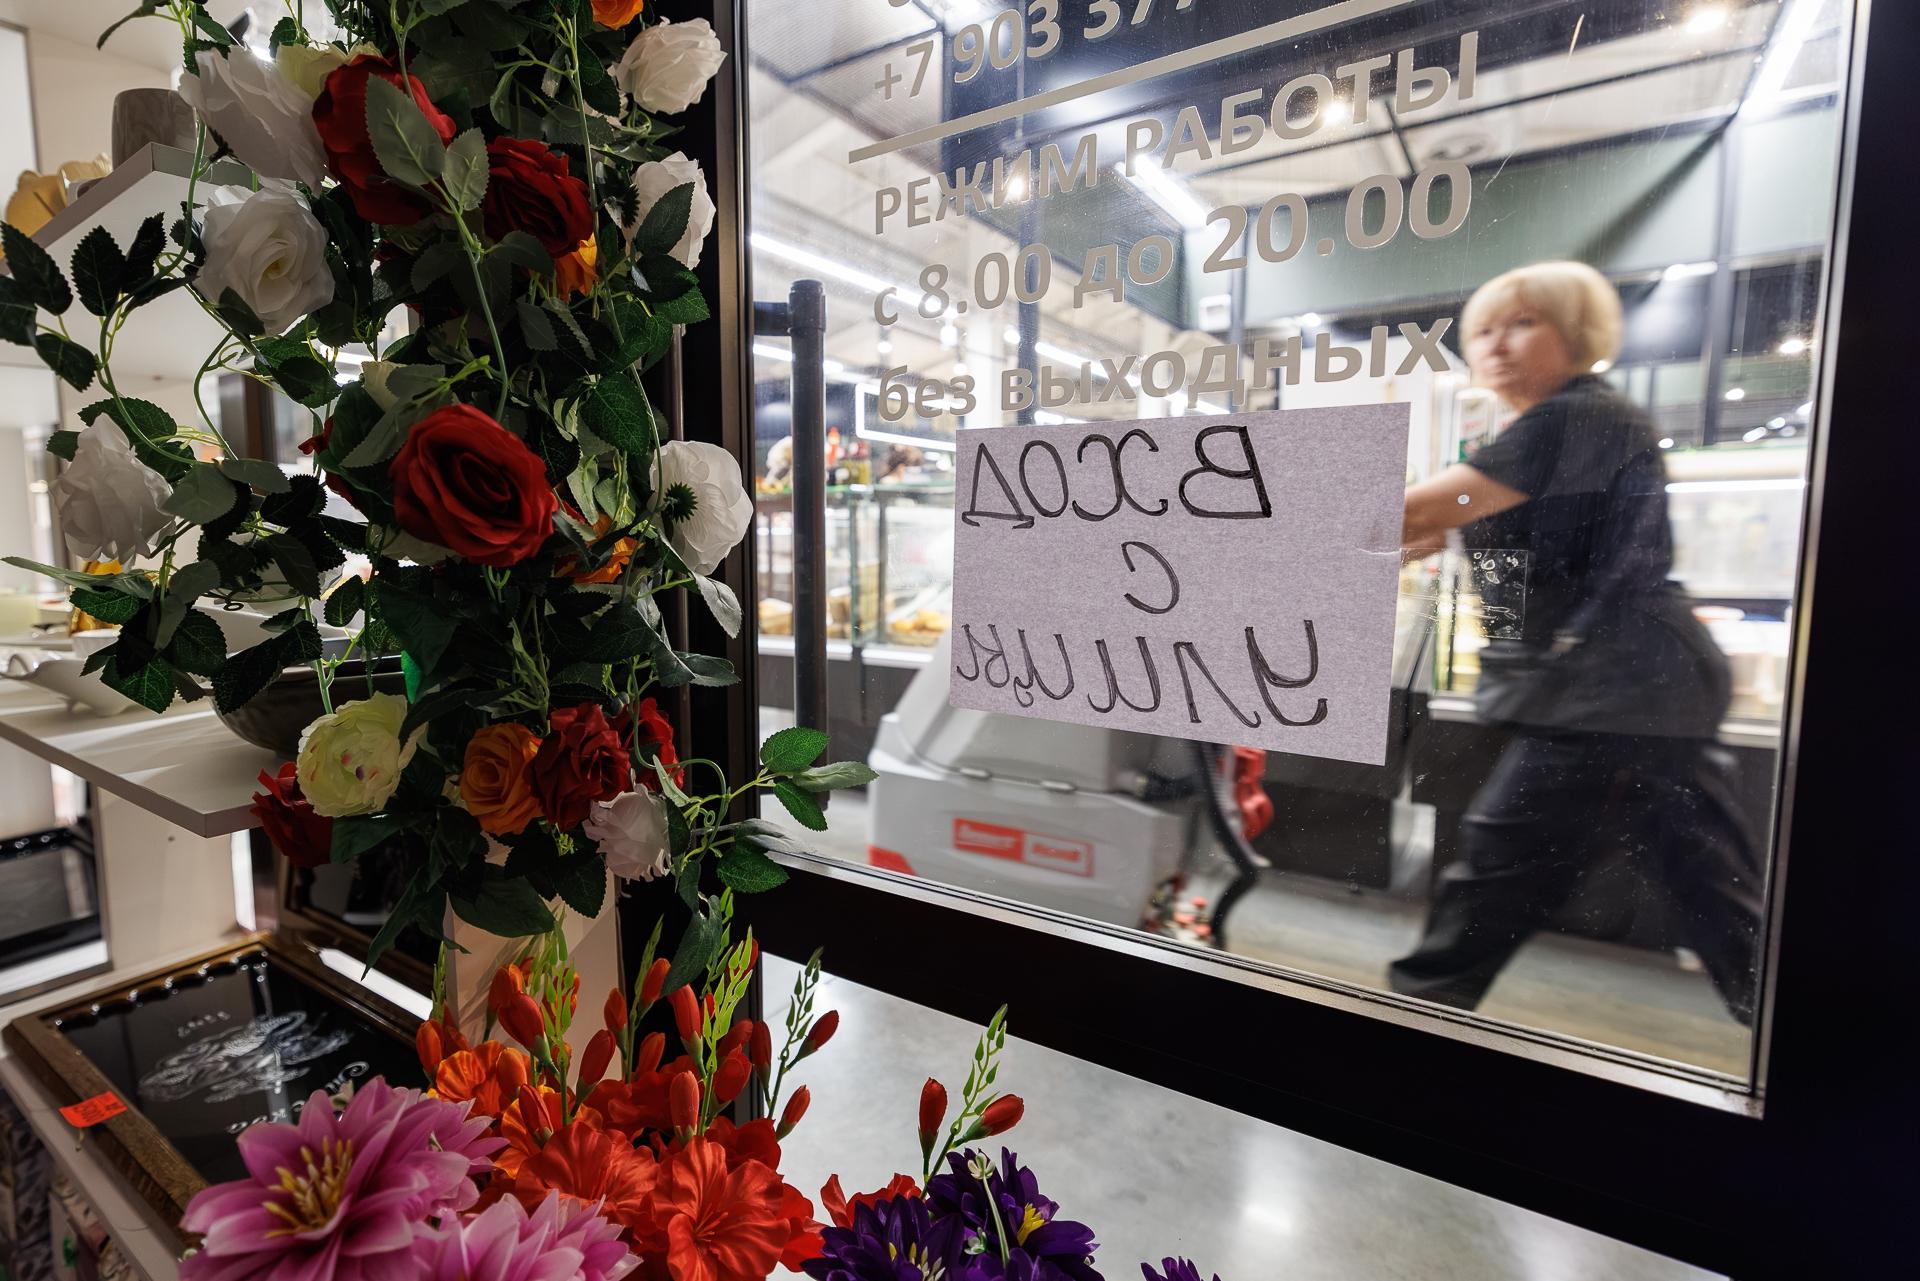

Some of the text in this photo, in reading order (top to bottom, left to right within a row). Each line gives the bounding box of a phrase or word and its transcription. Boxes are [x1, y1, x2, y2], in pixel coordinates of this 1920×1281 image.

[874, 40, 934, 100] +7
[953, 0, 1061, 83] 903
[875, 31, 1479, 234] РЕЖИМ РАБОТЫ
[874, 163, 1472, 326] с 8.00 до 20.00
[879, 318, 1454, 422] без выходных
